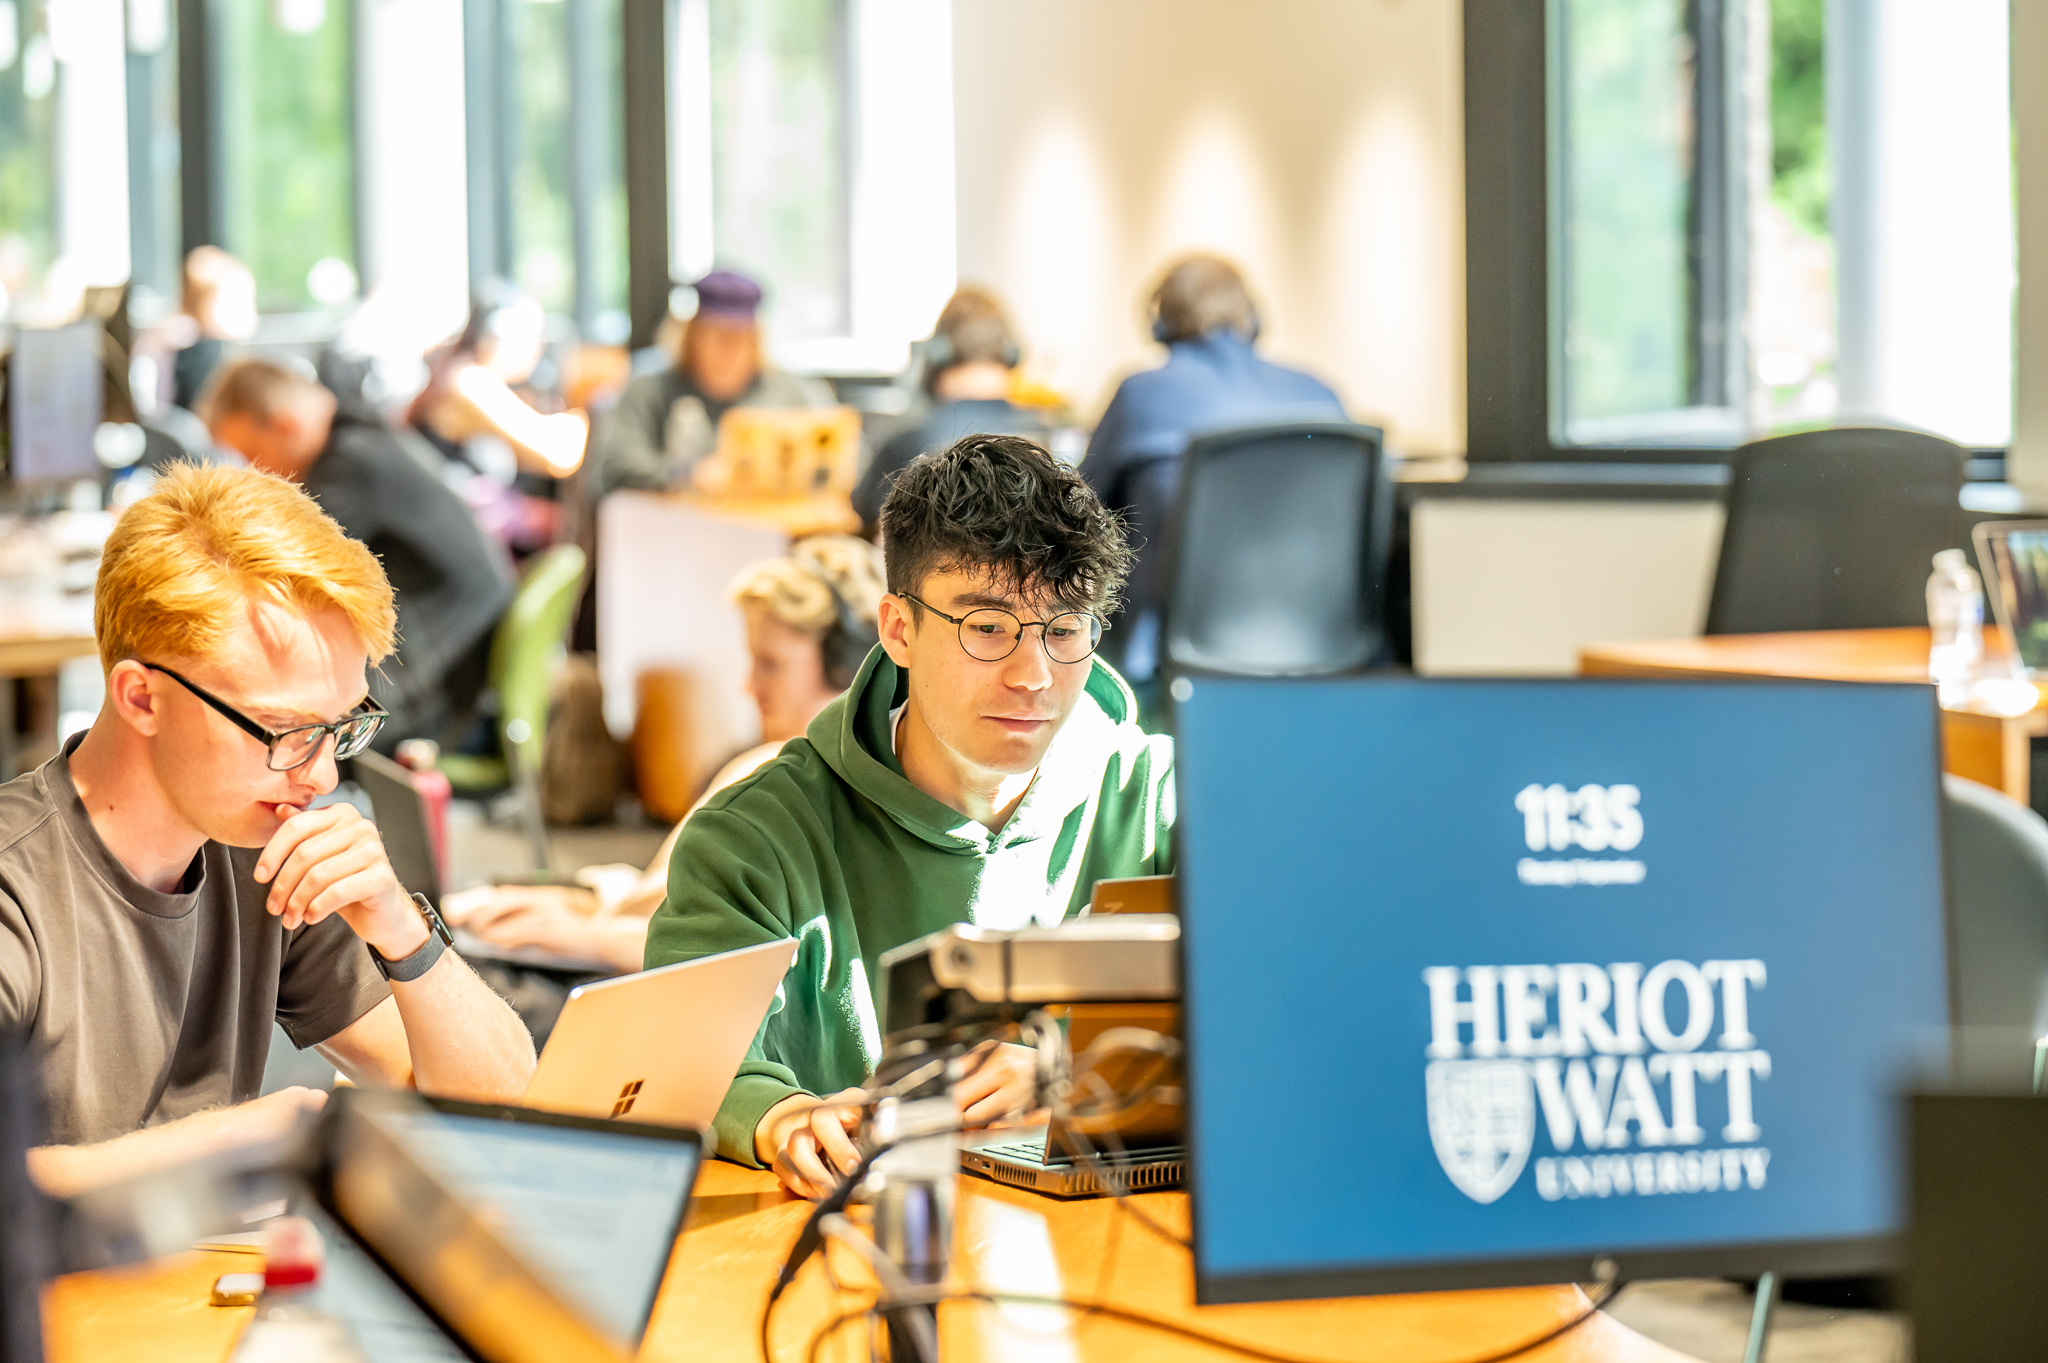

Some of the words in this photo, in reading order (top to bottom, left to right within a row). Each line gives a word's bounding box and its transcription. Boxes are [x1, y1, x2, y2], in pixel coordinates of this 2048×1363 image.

[1515, 783, 1643, 851] 11:35
[1423, 960, 1767, 1057] HERIOT
[1532, 1050, 1771, 1150] WATT
[1537, 1149, 1770, 1200] UNIVERSITY
